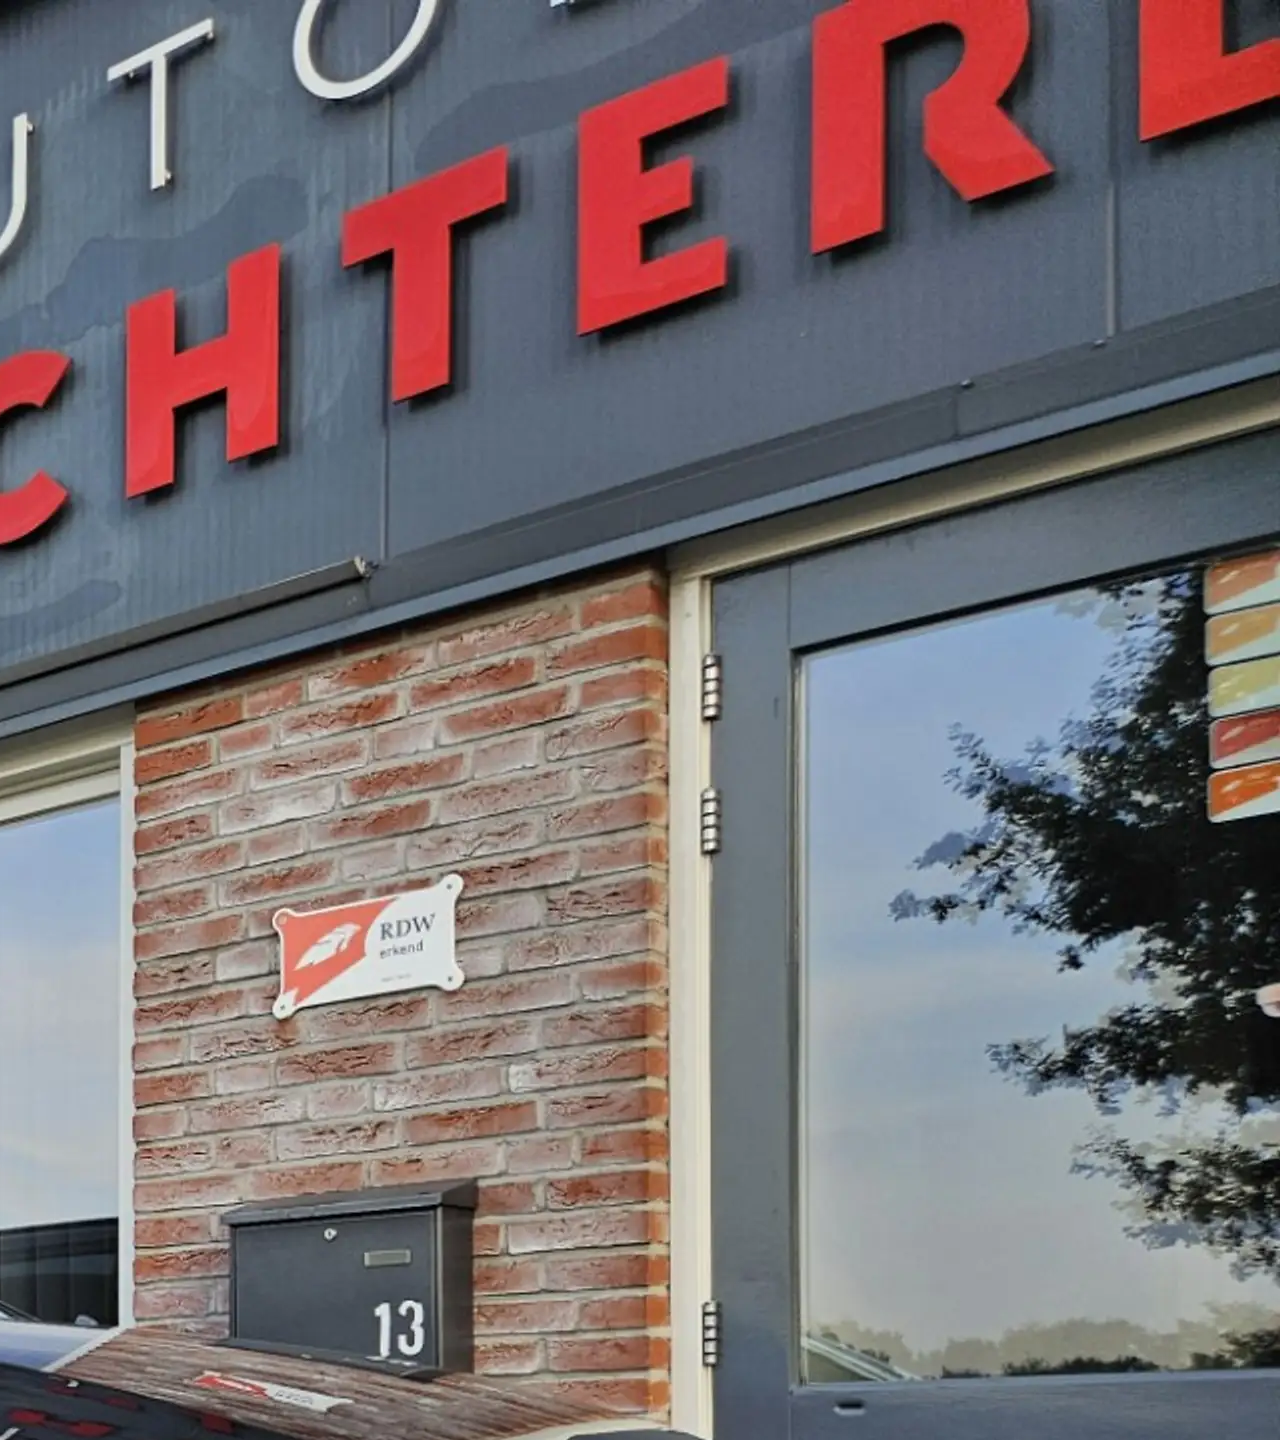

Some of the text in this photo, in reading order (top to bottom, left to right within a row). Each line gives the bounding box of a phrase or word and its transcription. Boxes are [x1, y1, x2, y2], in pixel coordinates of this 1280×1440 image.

[380, 912, 436, 940] RDW
[380, 939, 424, 959] erkend
[373, 1299, 426, 1358] 13
